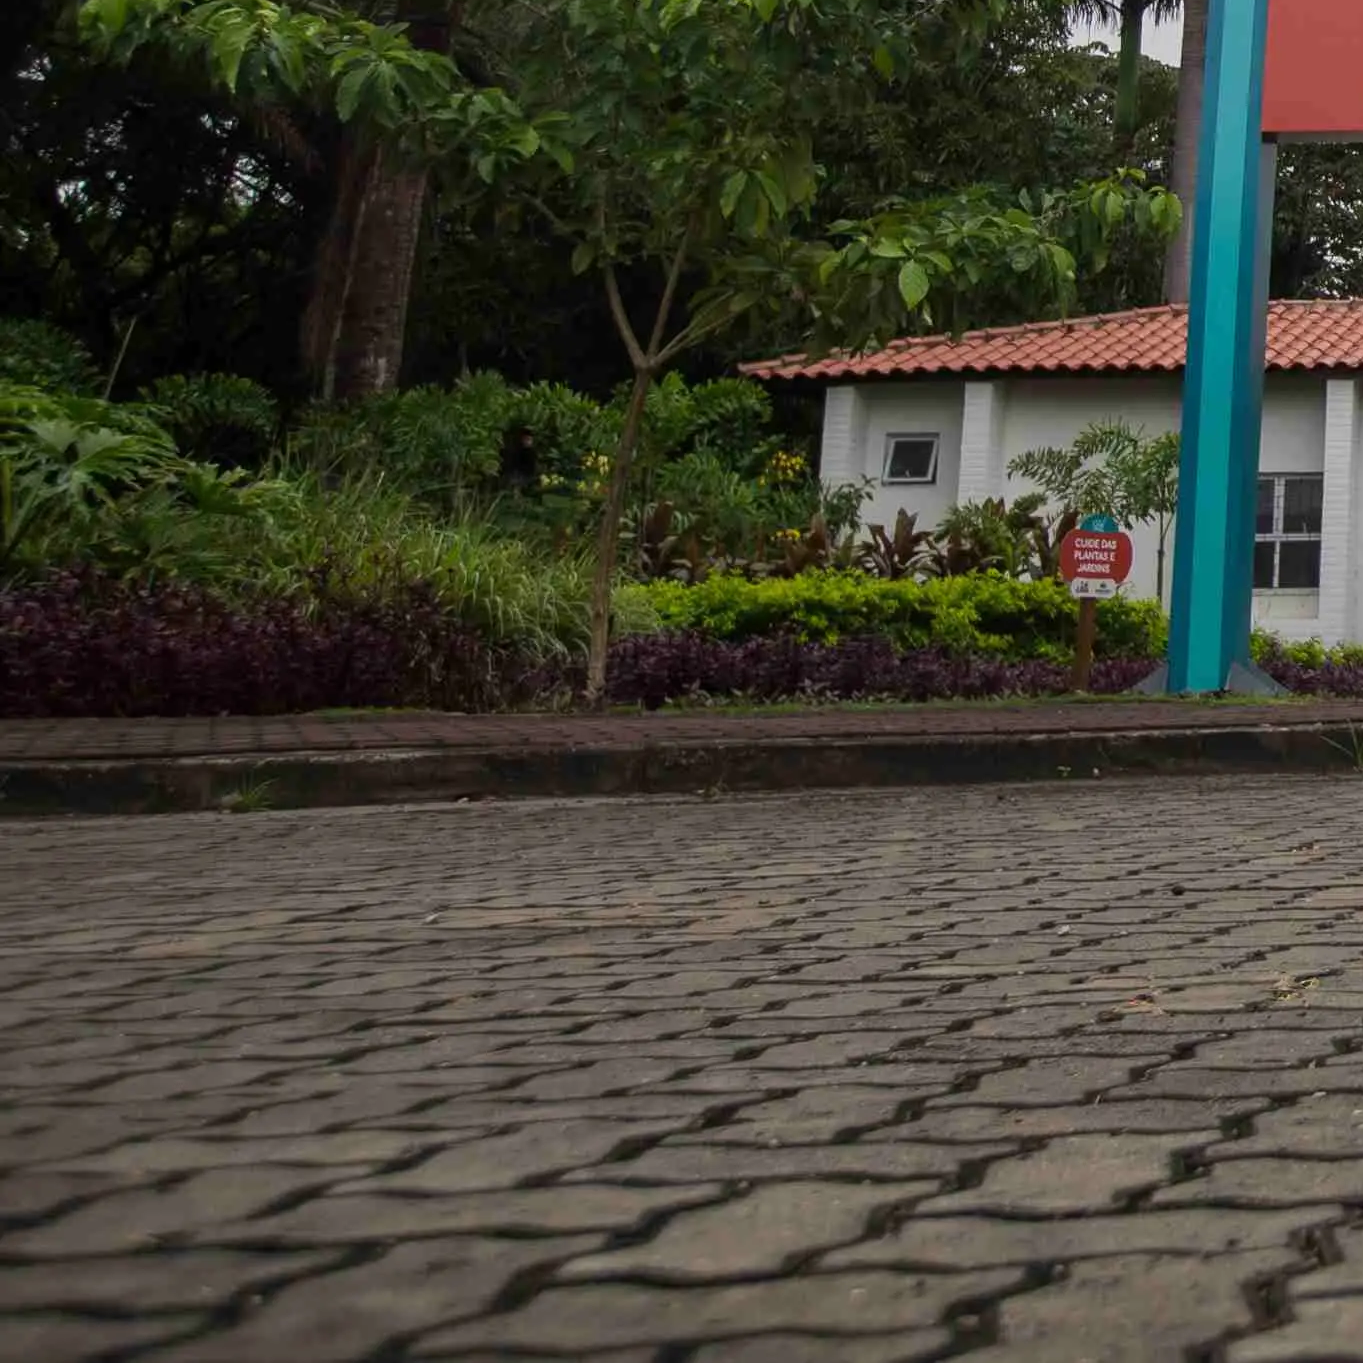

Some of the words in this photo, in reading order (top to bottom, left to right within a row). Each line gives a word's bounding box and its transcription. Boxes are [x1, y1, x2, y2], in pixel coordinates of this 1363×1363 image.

[1101, 539, 1117, 549] DAS
[1074, 550, 1109, 561] PLANTAS
[1110, 551, 1116, 562] E
